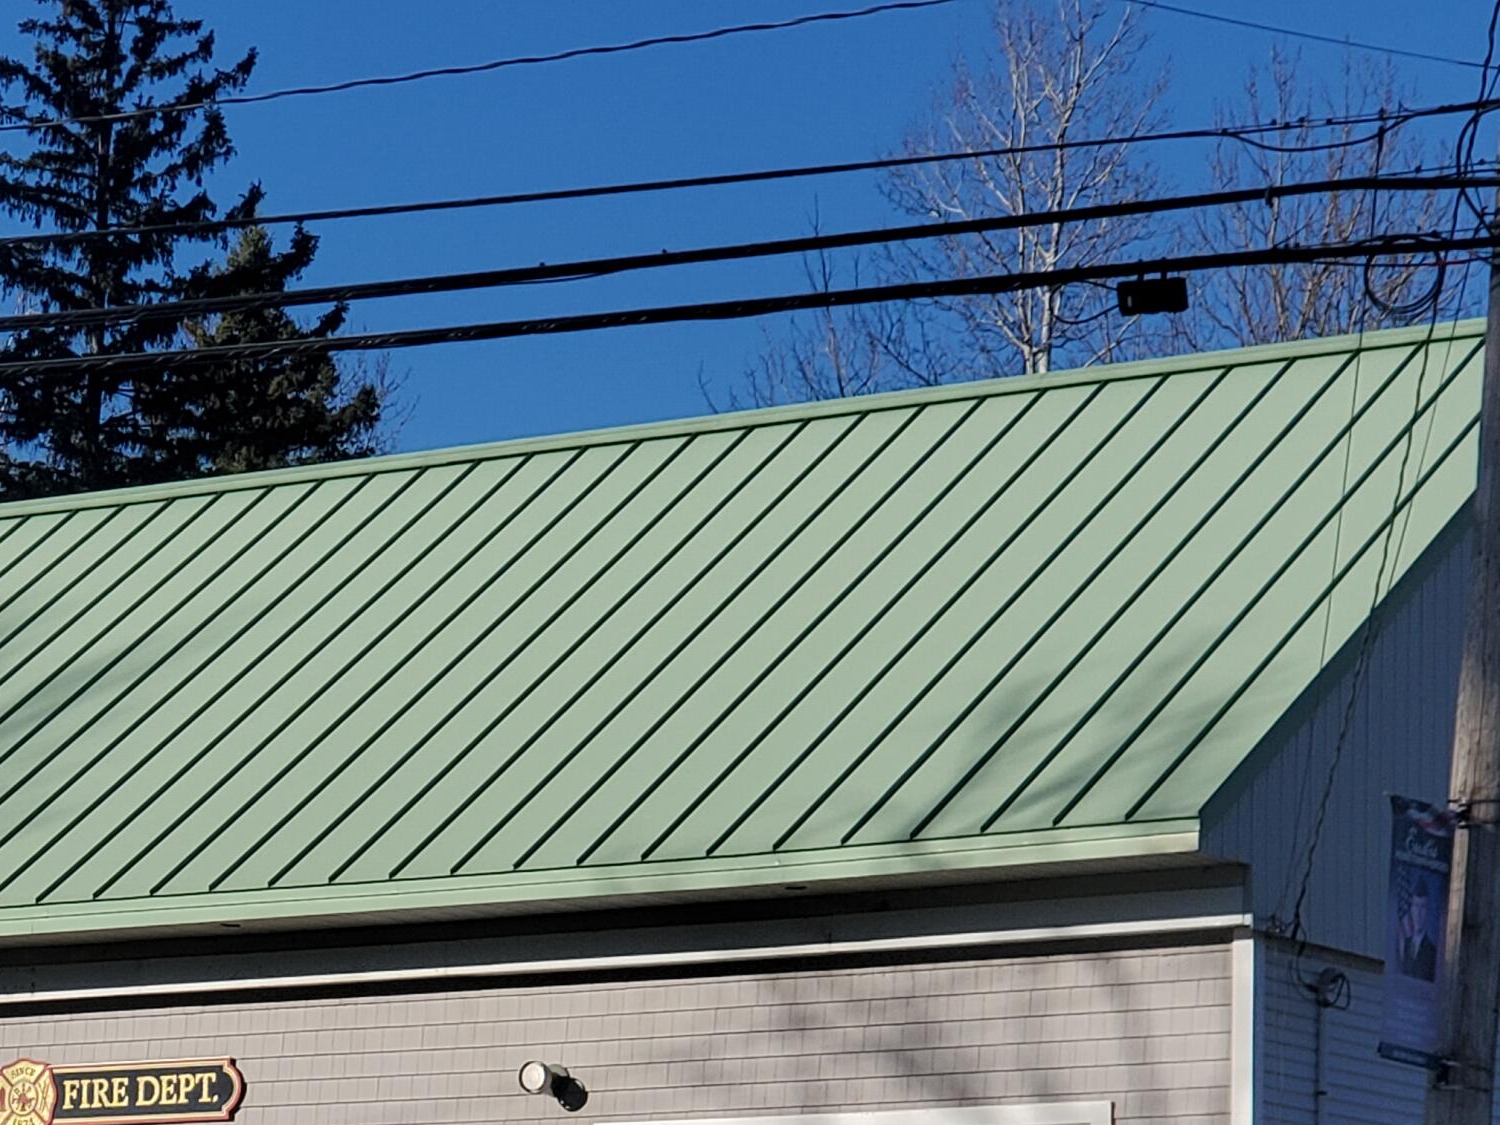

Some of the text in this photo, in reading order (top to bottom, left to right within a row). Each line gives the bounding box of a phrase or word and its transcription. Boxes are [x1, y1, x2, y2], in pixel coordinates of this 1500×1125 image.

[11, 1067, 36, 1080] SINCE
[62, 1077, 129, 1110] FIRE
[135, 1072, 219, 1106] DEPT.
